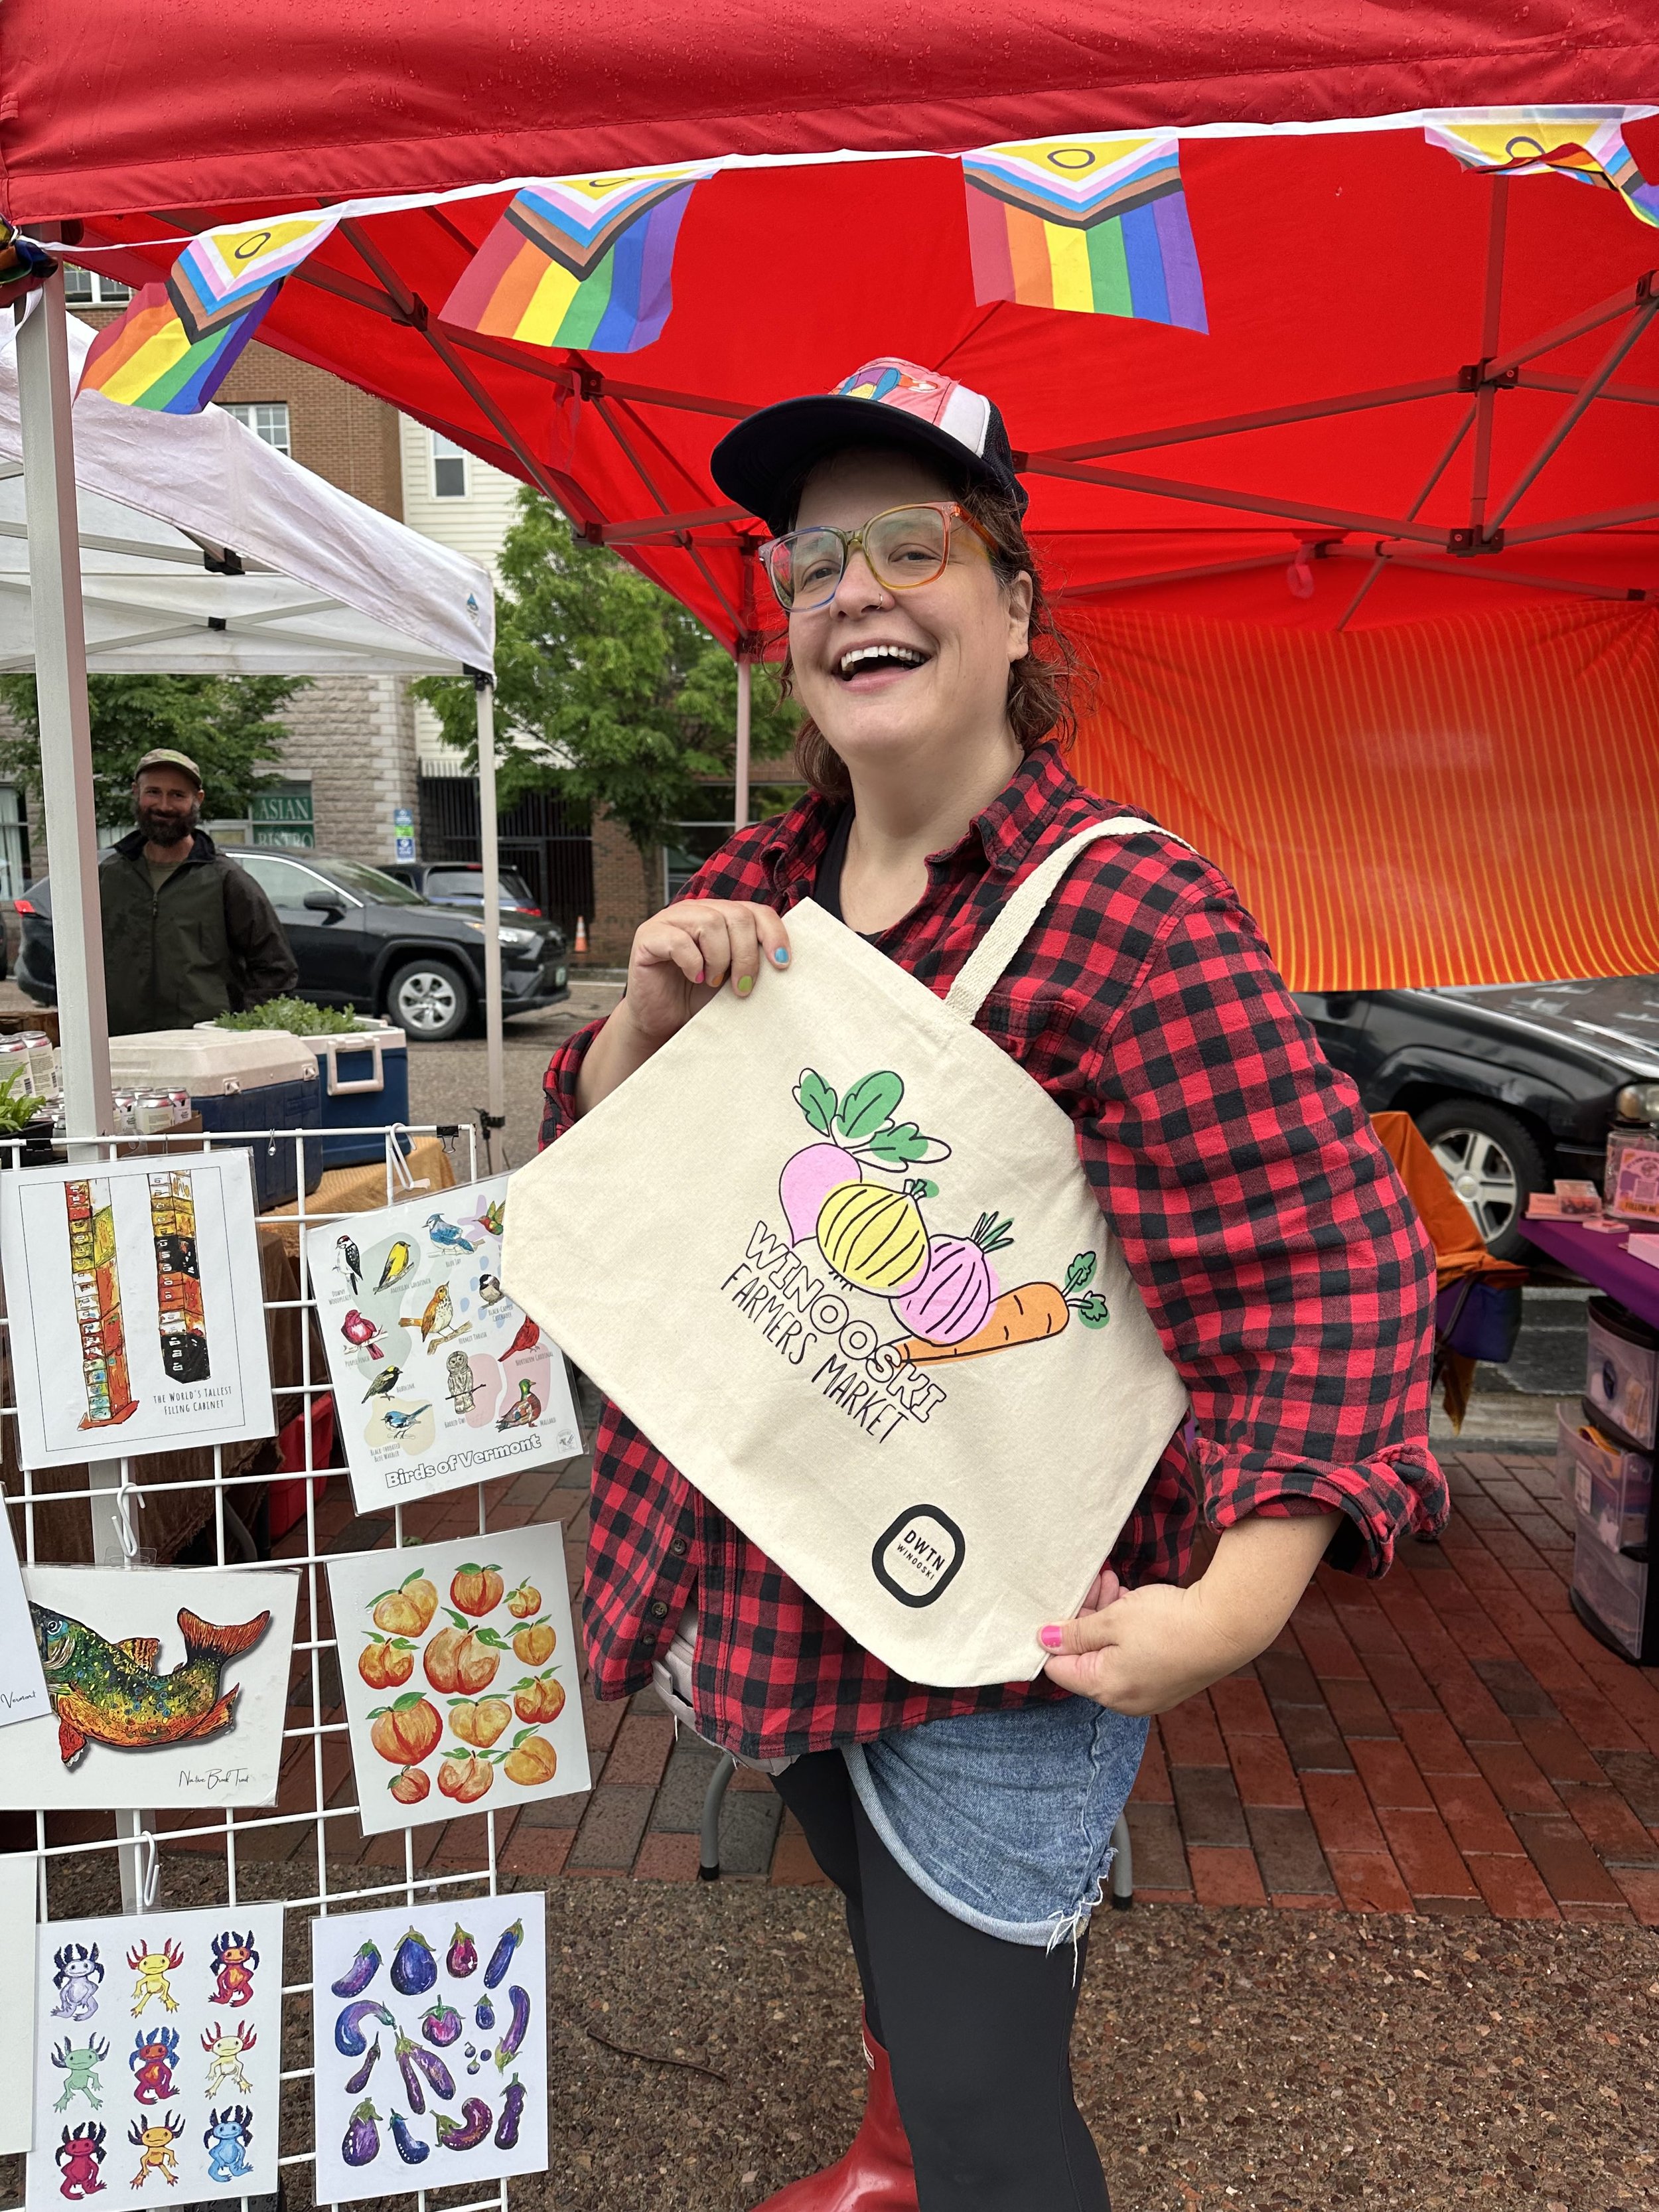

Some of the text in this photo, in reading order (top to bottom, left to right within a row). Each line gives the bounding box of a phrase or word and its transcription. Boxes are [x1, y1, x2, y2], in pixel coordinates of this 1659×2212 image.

[259, 798, 309, 820] ASIAN
[257, 832, 314, 848] BISTRO
[745, 1220, 947, 1423] WINOOSKI
[721, 1262, 909, 1444] FARMERS MARKET
[153, 1386, 232, 1404] THE WORLD'S TALLEST
[164, 1400, 224, 1415] FILING CABINET
[540, 1417, 556, 1426] MALLARD
[385, 1463, 436, 1489] Birds
[437, 1454, 458, 1474] of
[458, 1434, 541, 1467] Vermont
[903, 1529, 945, 1571] DWTN
[897, 1544, 935, 1581] WINOOSKI
[1, 1690, 36, 1708] Vermont
[179, 1767, 250, 1790] Native Brook Trout
